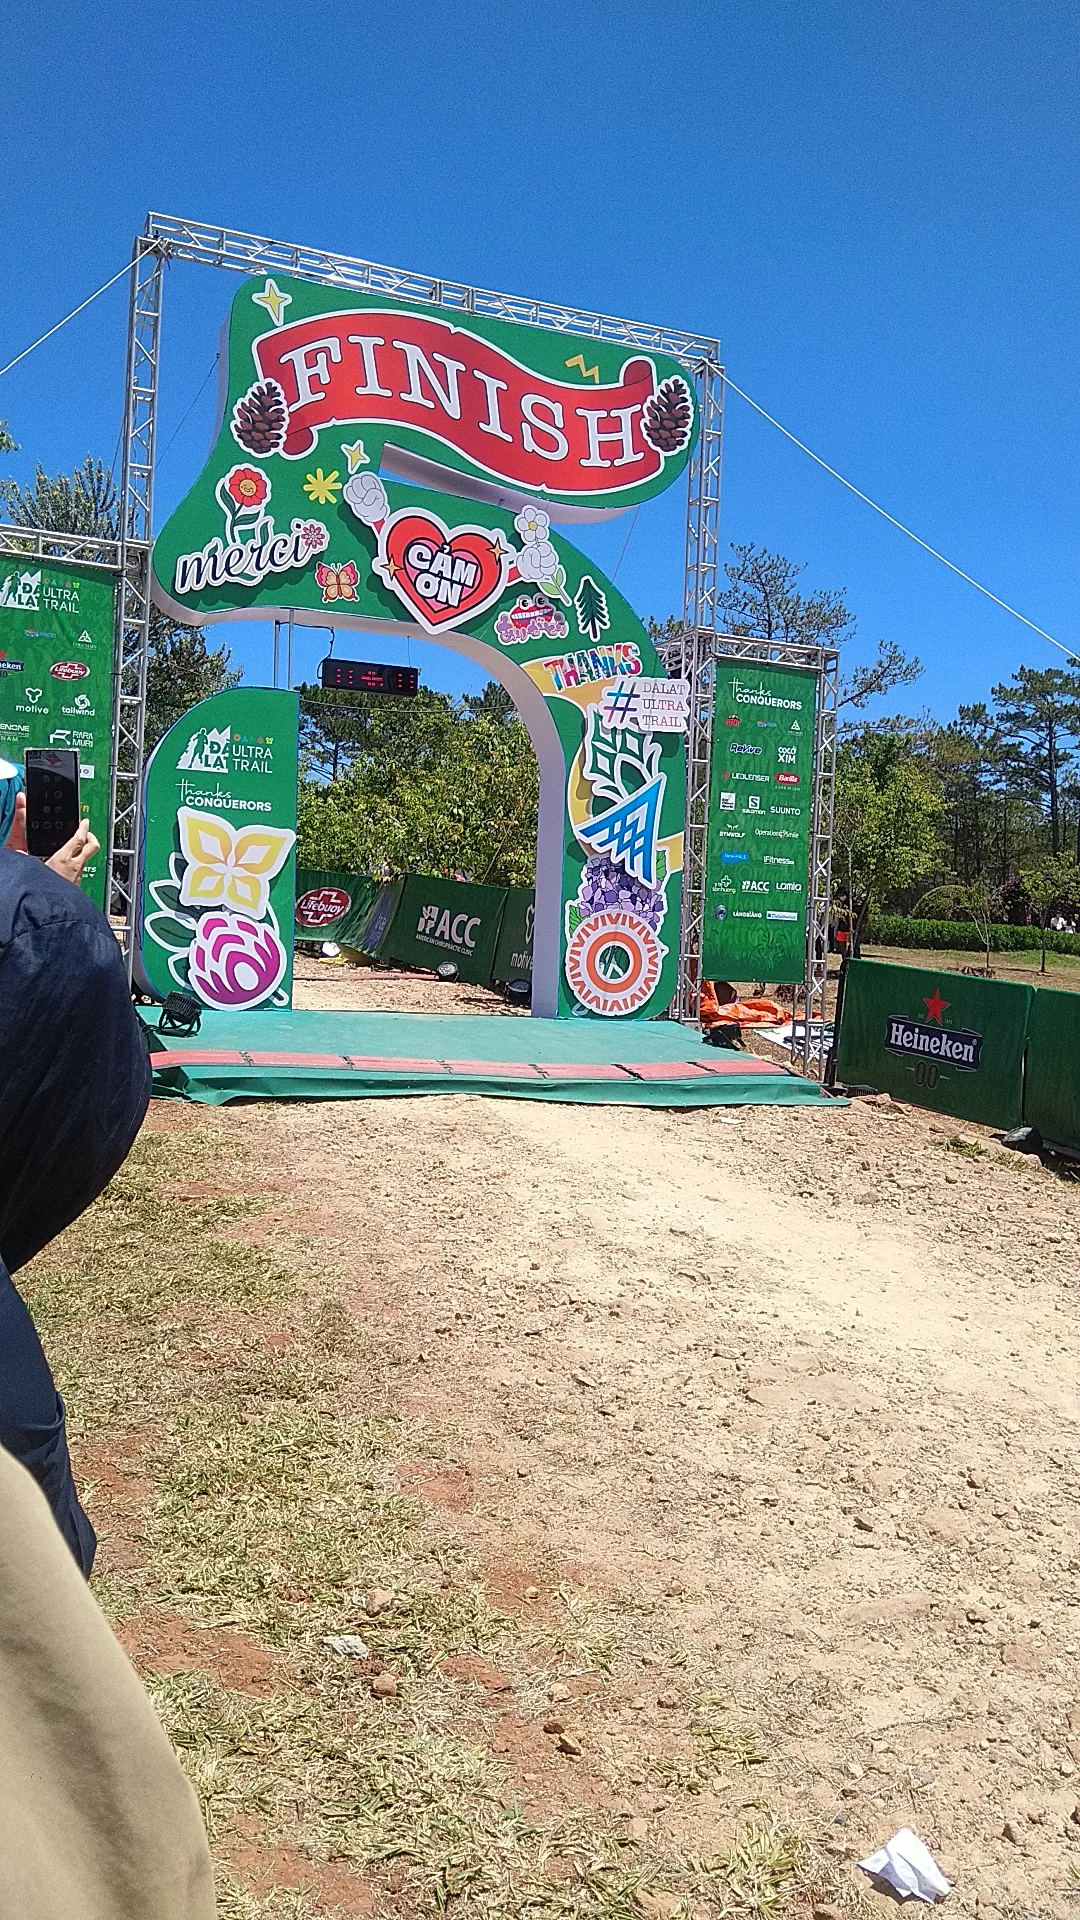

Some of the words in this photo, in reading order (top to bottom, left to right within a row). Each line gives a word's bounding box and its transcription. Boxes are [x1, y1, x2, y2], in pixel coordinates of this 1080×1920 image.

[279, 335, 645, 467] FINISH
[179, 522, 309, 588] merci
[43, 586, 79, 601] ULTRA
[43, 599, 79, 613] TRAIL
[543, 643, 642, 691] THANKS
[642, 682, 686, 695] DALAT
[642, 699, 686, 711] ULTRA
[736, 694, 802, 710] CONQUERORS
[16, 705, 49, 714] motive
[62, 706, 95, 716] tailwind
[642, 715, 682, 727] TRAIL
[232, 745, 273, 759] ULTRA
[778, 754, 796, 764] XIM
[233, 758, 273, 773] TRAIL
[185, 796, 272, 811] CONQUERORS
[770, 806, 801, 816] SUUNTO
[750, 882, 770, 891] ACC
[300, 898, 344, 914] Lifebuoy
[435, 909, 481, 948] ACC
[415, 934, 436, 945] AMERICAN
[890, 1023, 975, 1062] Heineken
